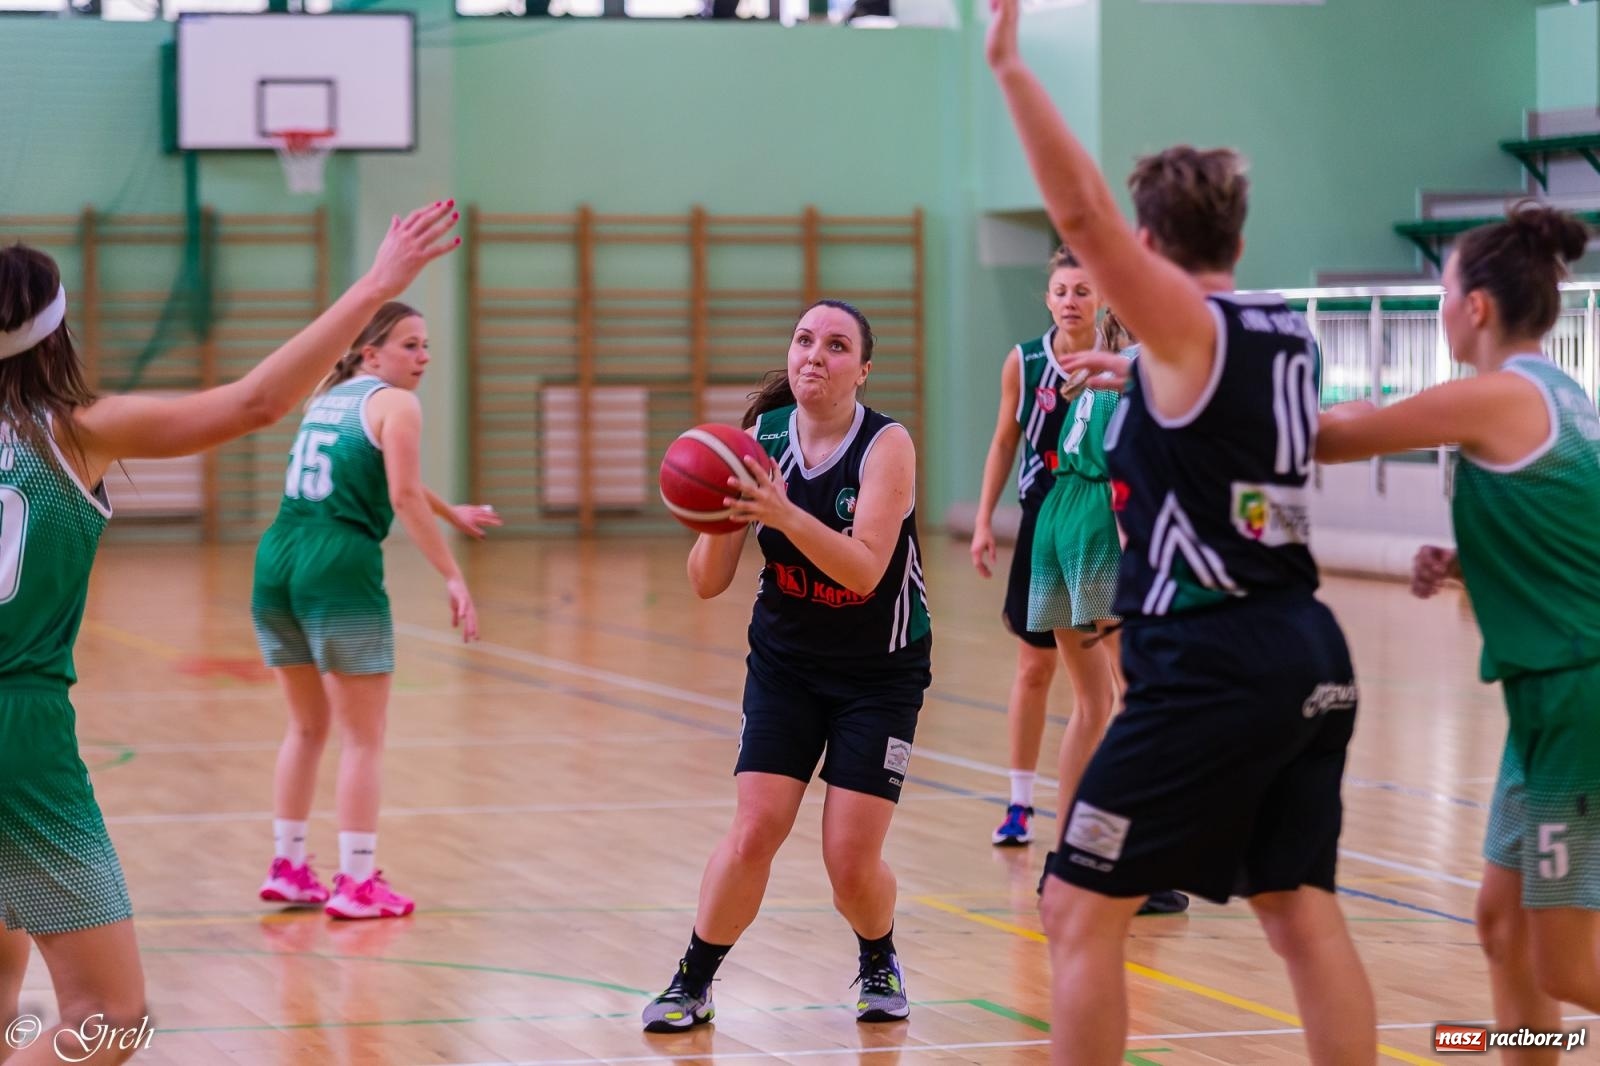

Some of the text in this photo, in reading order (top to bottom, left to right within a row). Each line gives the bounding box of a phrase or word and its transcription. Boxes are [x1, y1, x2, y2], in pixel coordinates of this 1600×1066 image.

[760, 431, 789, 440] COLO
[1272, 351, 1320, 476] 10
[285, 430, 340, 502] 15
[1537, 823, 1569, 880] 5
